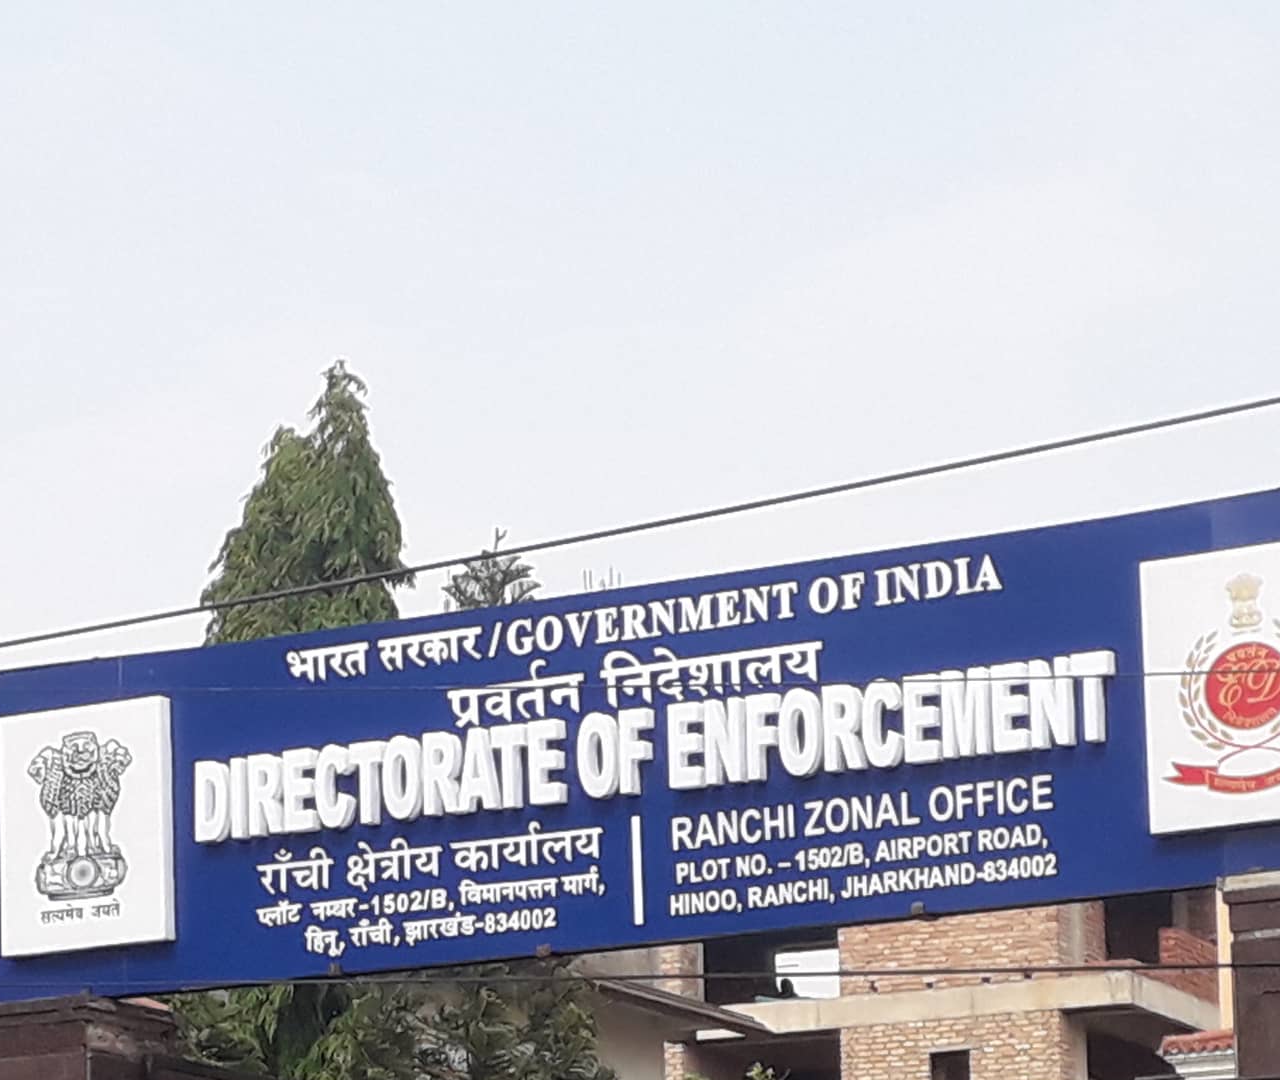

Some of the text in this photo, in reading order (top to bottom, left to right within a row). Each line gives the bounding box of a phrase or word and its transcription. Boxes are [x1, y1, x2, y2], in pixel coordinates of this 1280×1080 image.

[286, 641, 369, 682] भारत
[378, 626, 483, 672] सरकार
[808, 570, 866, 615] OF
[874, 553, 1003, 607] INDIA
[446, 640, 824, 728] प्रवर्तन निदेशालय
[194, 649, 1116, 843] DIRECTORATE OF ENFORCEMENT
[671, 773, 1054, 851] RANCHI ZONAL OFFICE
[256, 821, 604, 894] राँची क्षेत्रीय कार्यालय
[669, 852, 1058, 917] HINOO, RANCHI, JHARKHAND-834002
[675, 857, 732, 884] PLOT
[736, 853, 773, 878] NO.
[874, 830, 974, 864] AIRPORT
[977, 823, 1049, 852] ROAD,
[40, 898, 120, 924] सत्यमेव जयते
[256, 900, 302, 927] प्लॉट
[459, 877, 559, 906] विमानपत्तन
[561, 865, 606, 897] मार्ग,
